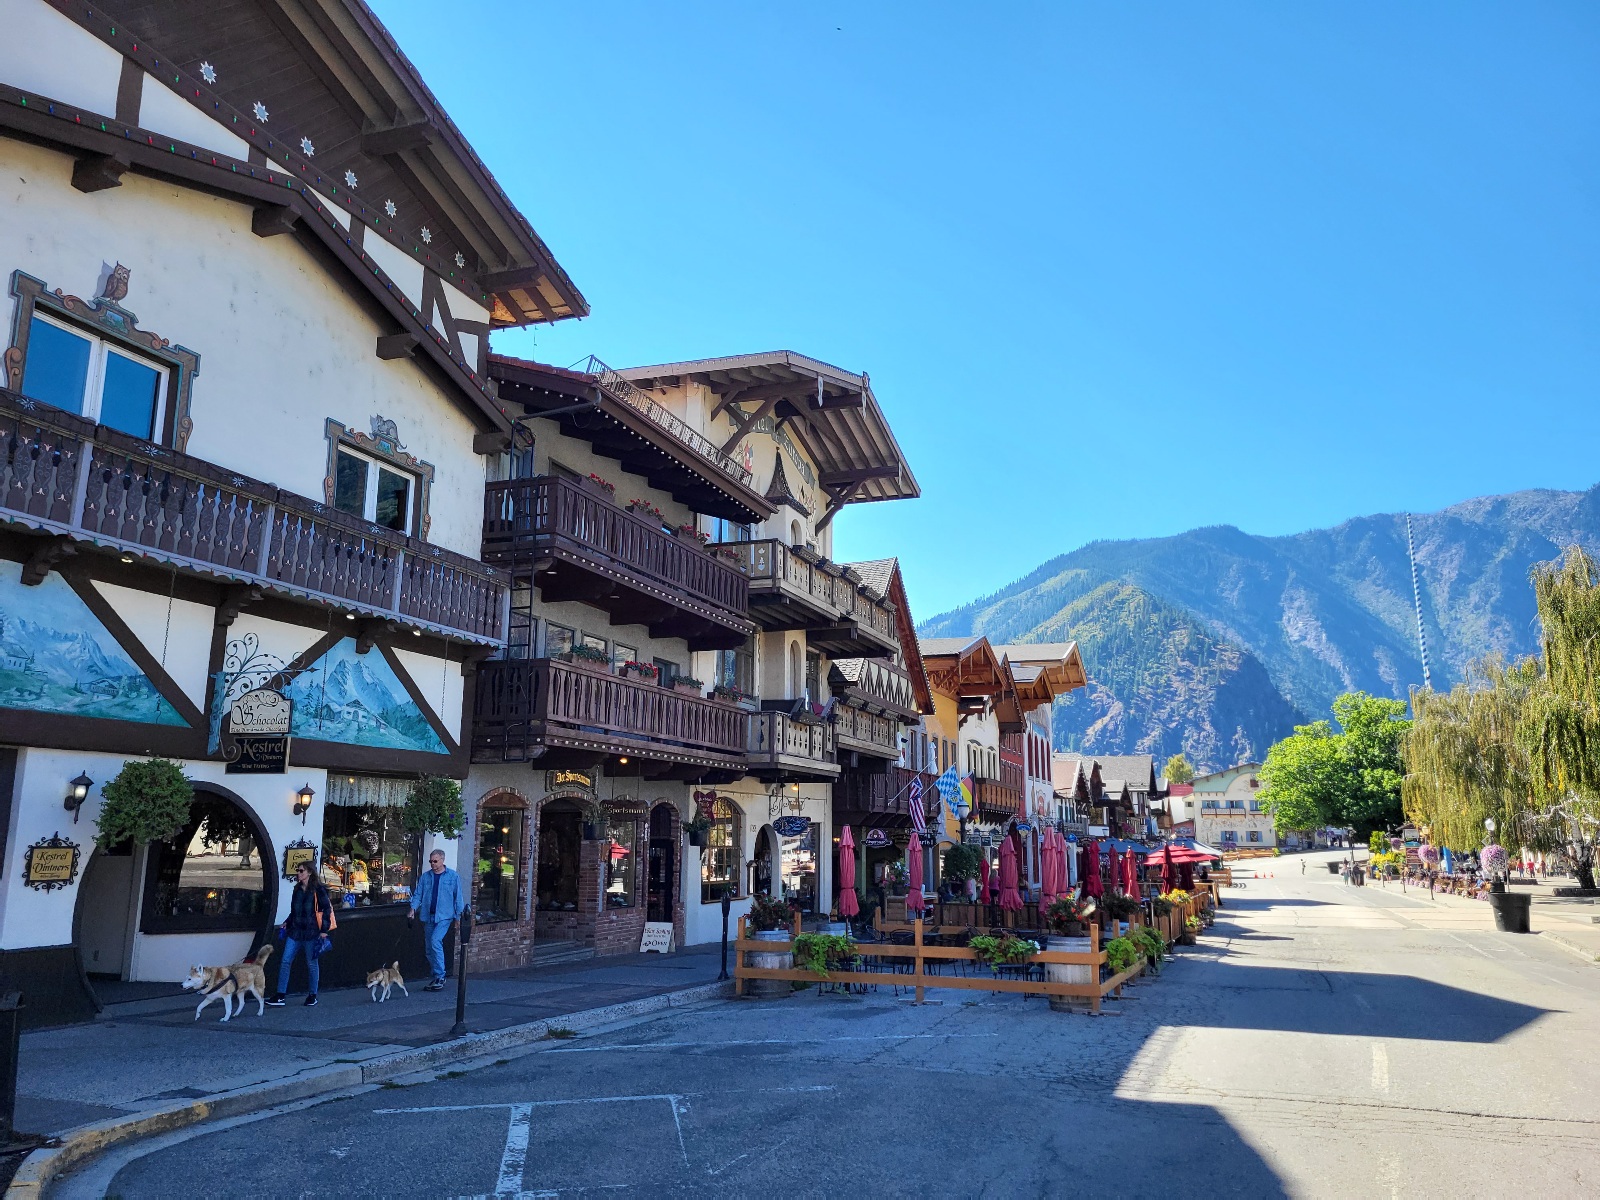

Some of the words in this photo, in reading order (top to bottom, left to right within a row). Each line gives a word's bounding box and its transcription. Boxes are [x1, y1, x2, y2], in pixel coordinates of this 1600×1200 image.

[784, 432, 805, 476] Europa
[242, 738, 286, 757] Kestrel
[556, 772, 566, 784] Der
[608, 806, 645, 815] Sportsmann
[37, 851, 70, 862] Kestrel
[33, 863, 71, 873] Vintners
